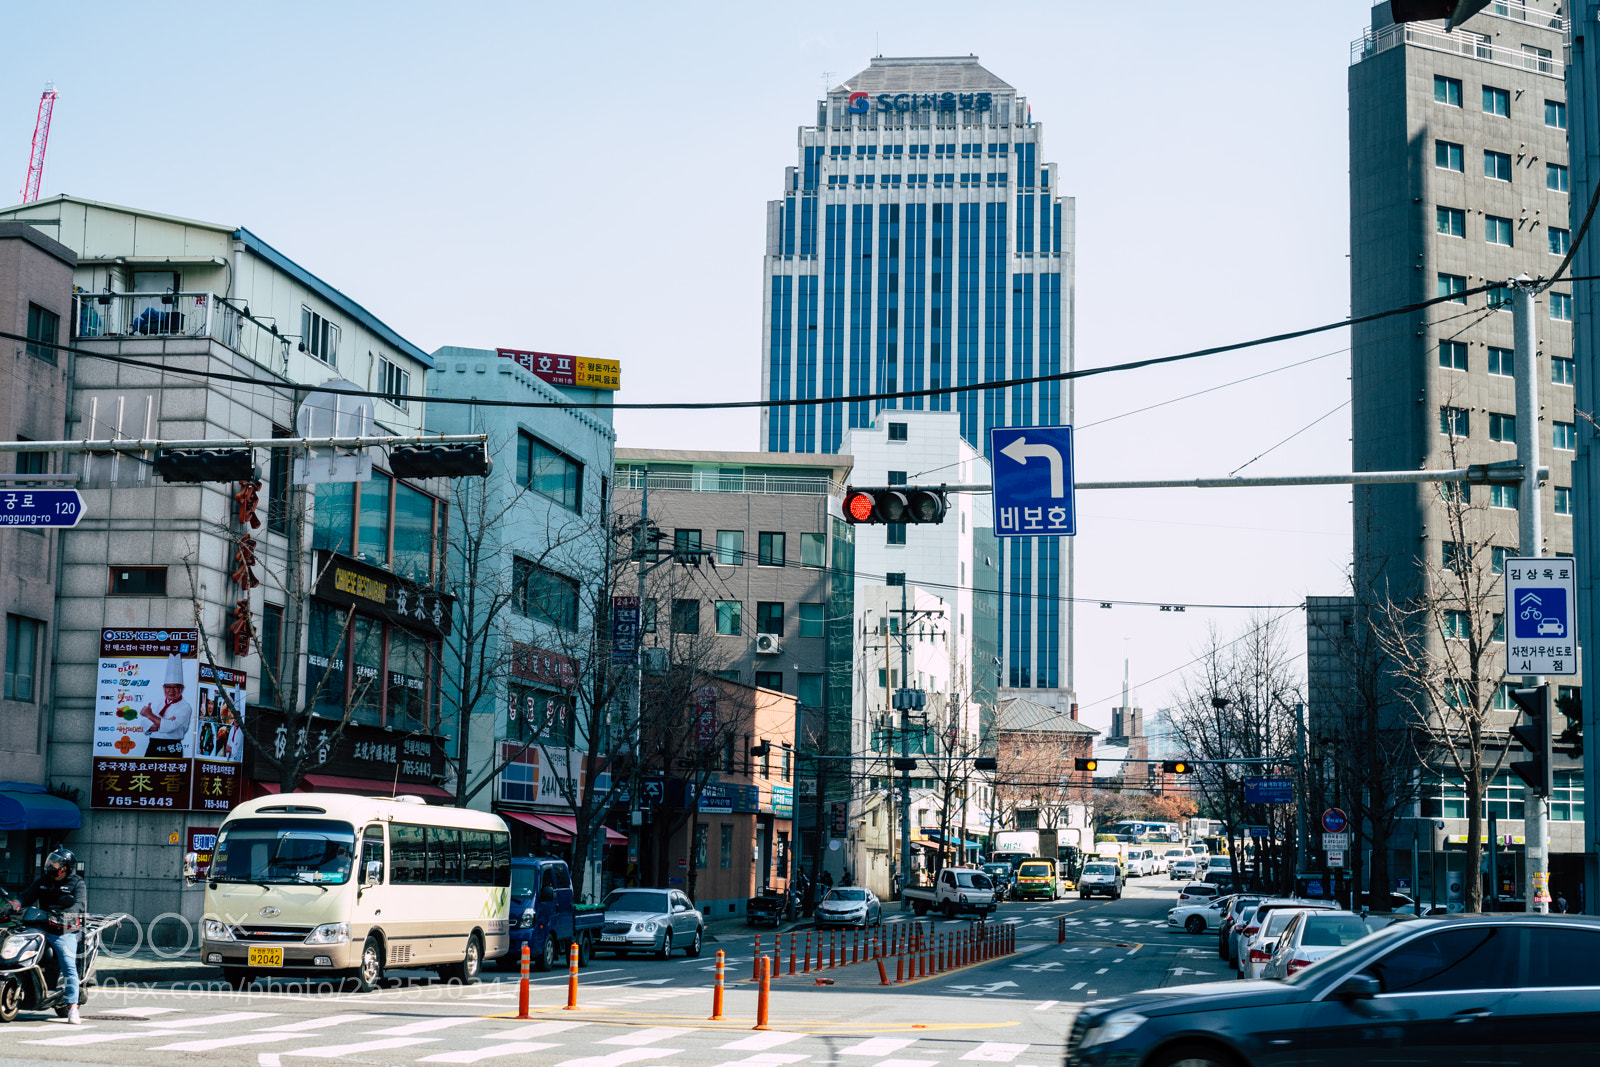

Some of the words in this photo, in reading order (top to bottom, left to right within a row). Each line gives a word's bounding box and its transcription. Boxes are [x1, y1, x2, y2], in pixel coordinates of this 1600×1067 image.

[587, 363, 618, 373] 왕돈까스
[55, 502, 76, 514] 120
[1000, 506, 1068, 531] 비보호
[1510, 568, 1570, 580] 김상옥로
[335, 568, 357, 595] CHINESE
[356, 575, 387, 605] RESTAURANT
[114, 631, 133, 640] SBS
[135, 631, 158, 640] KBS
[1511, 645, 1573, 657] 자전거우선도로
[98, 761, 187, 772] 중국정통요리전문점
[402, 759, 431, 777] 765-5443
[107, 796, 173, 806] 765-5443
[204, 799, 229, 809] 765-5443
